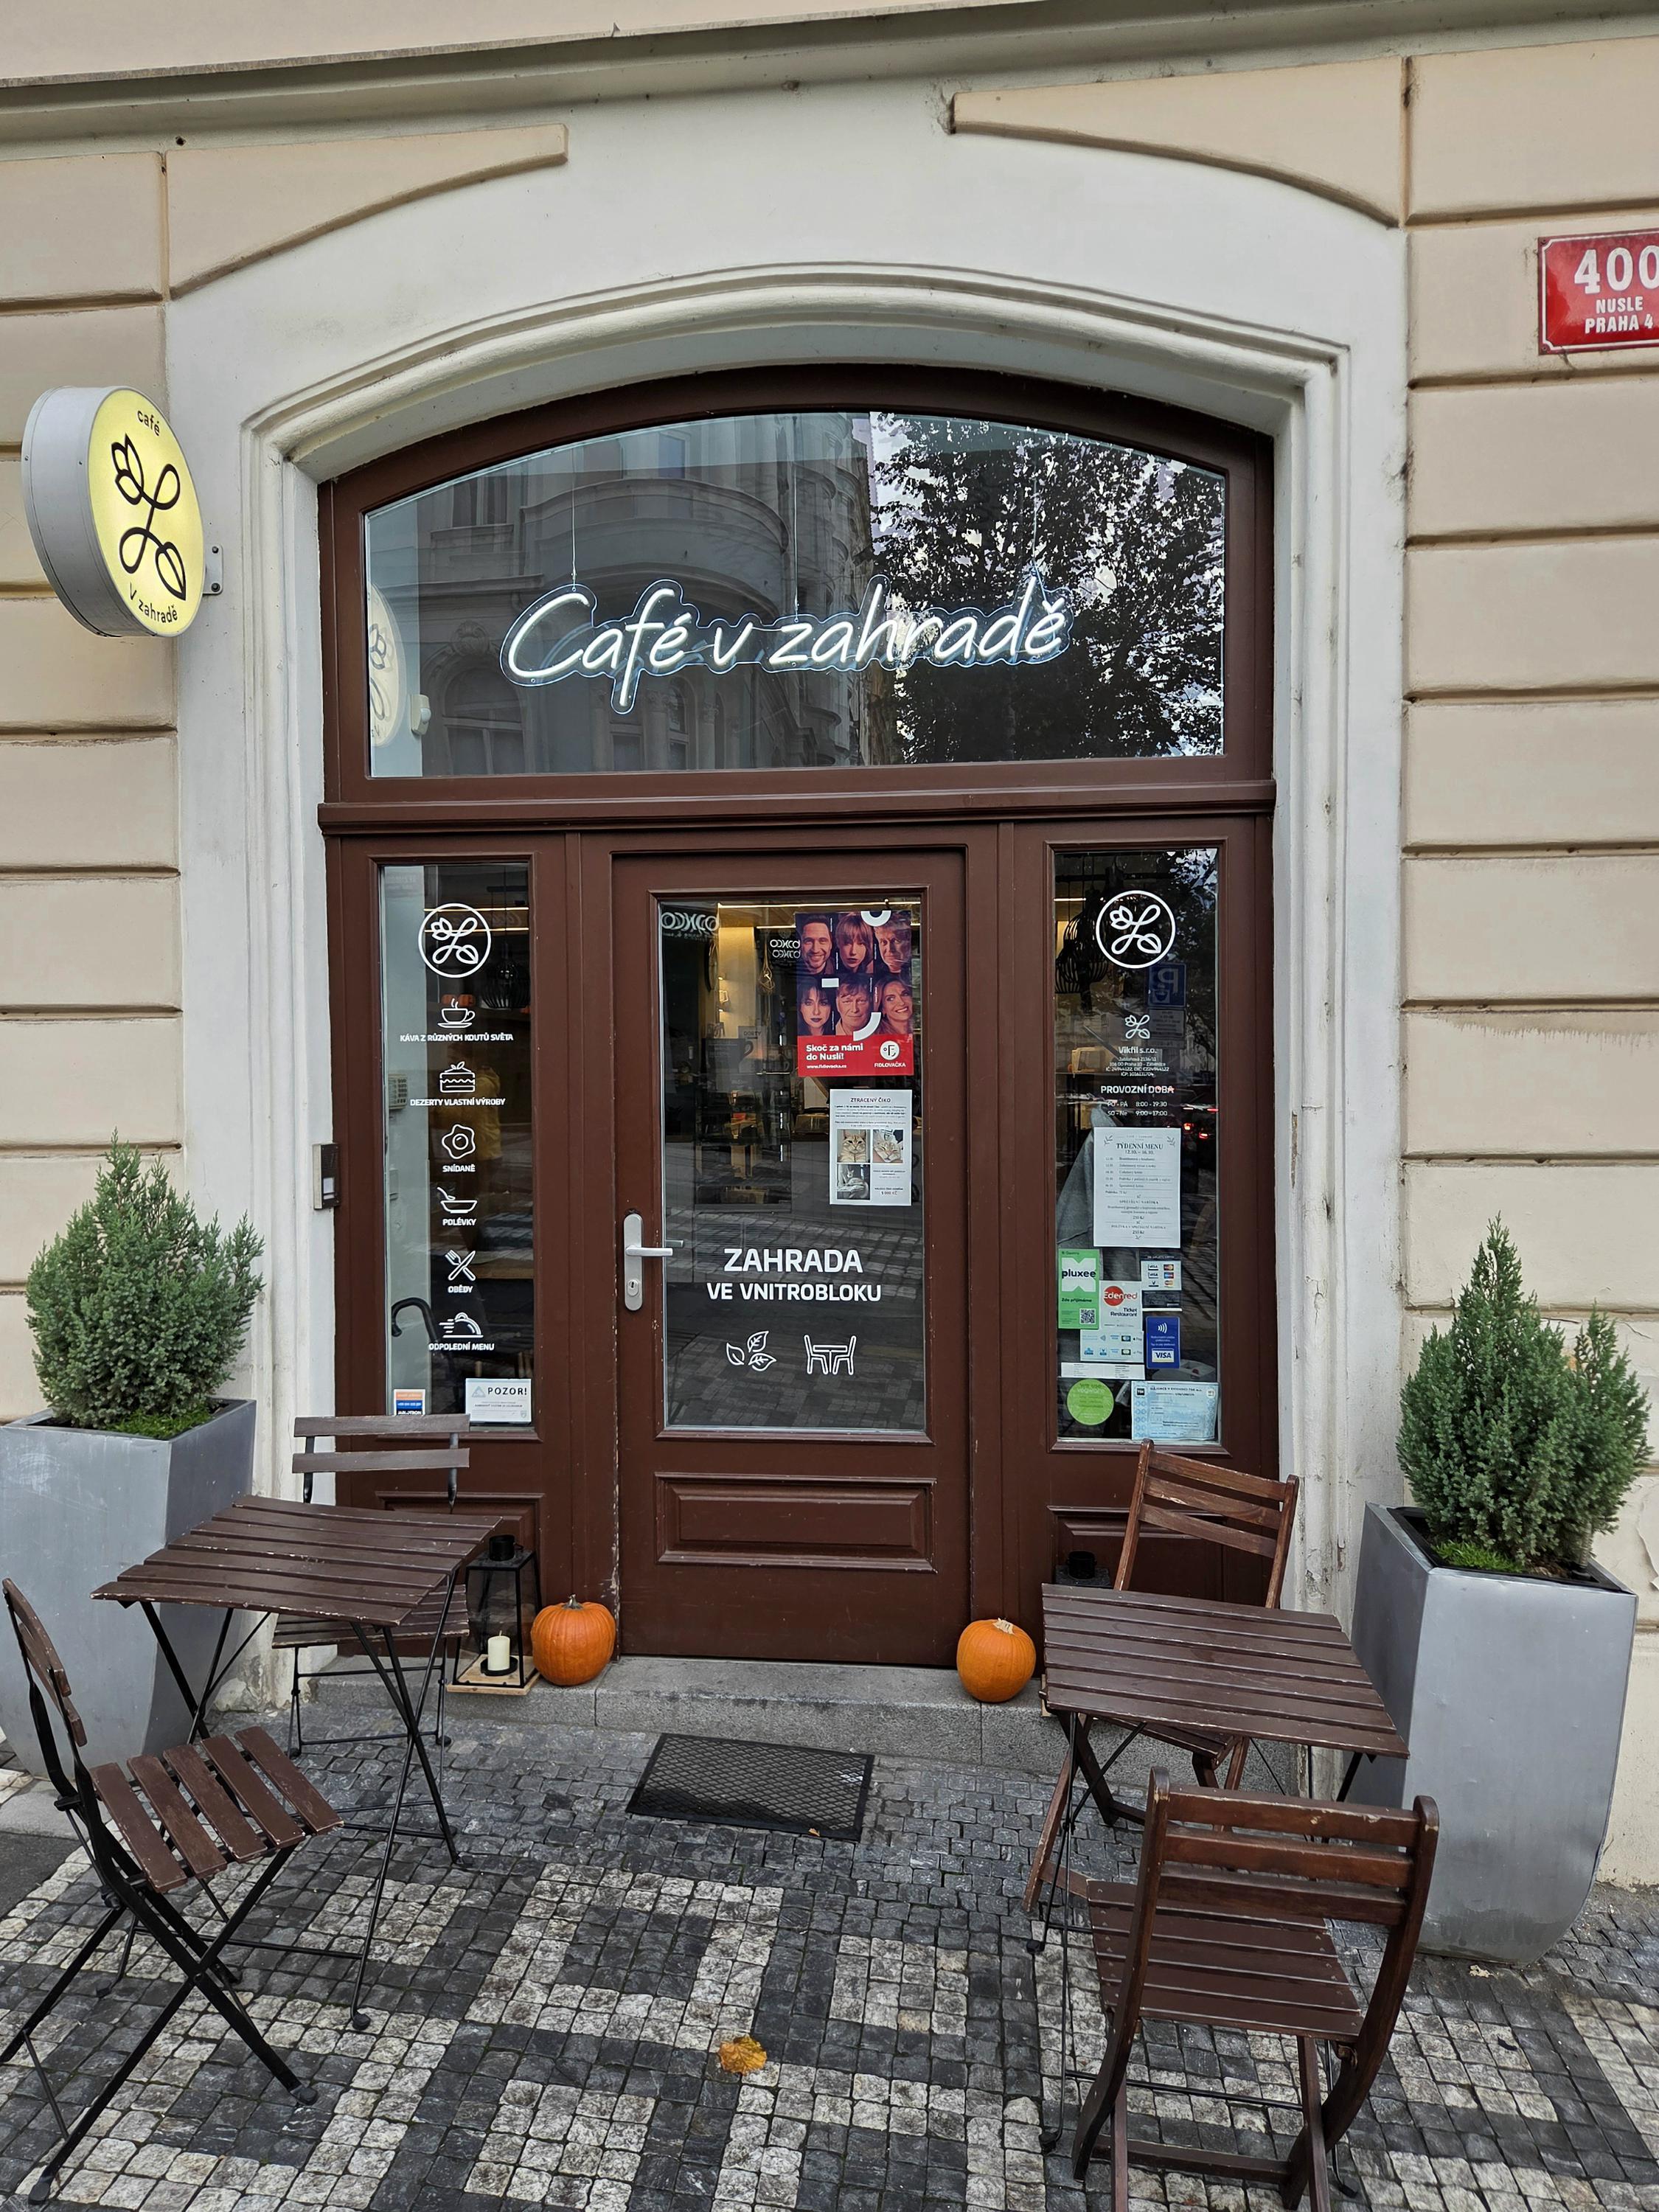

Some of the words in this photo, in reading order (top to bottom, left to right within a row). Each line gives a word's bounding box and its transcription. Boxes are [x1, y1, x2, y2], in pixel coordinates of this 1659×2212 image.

[1574, 245, 1659, 294] 400
[1596, 296, 1644, 314] NUSLE
[1585, 315, 1639, 334] PRAHA
[1644, 313, 1654, 329] 4
[137, 410, 160, 437] café
[139, 599, 178, 623] zahradě
[507, 588, 692, 707] Café
[712, 621, 754, 665] v
[769, 575, 1065, 664] zahradě
[400, 1033, 420, 1042] KÁVA
[428, 1033, 463, 1042] RŮZNÝCH
[465, 1032, 490, 1041] KOUTŮ
[490, 1032, 514, 1041] SVĚTA
[806, 1043, 827, 1052] Skoč
[841, 1043, 863, 1051] námi
[1118, 1046, 1138, 1054] Vikfil
[806, 1053, 818, 1061] do
[1101, 1084, 1147, 1093] PROVOZNÍ
[1149, 1085, 1175, 1093] DOBA
[444, 1097, 475, 1106] VLASTNÍ
[476, 1097, 506, 1106] VÝROBY
[442, 1164, 476, 1172] SNÍDANĚ
[442, 1217, 477, 1226] POLÉVKY
[724, 1248, 863, 1273] ZAHRADA
[1062, 1268, 1096, 1279] pluxee
[448, 1284, 473, 1293] OBĚDY
[706, 1282, 733, 1300] VE
[740, 1283, 881, 1301] VNITROBLOKU
[1104, 1291, 1138, 1300] Edenred
[428, 1342, 470, 1351] ODPOLEDNÍ
[472, 1343, 495, 1351] MENU
[487, 1387, 527, 1396] POZOR!
